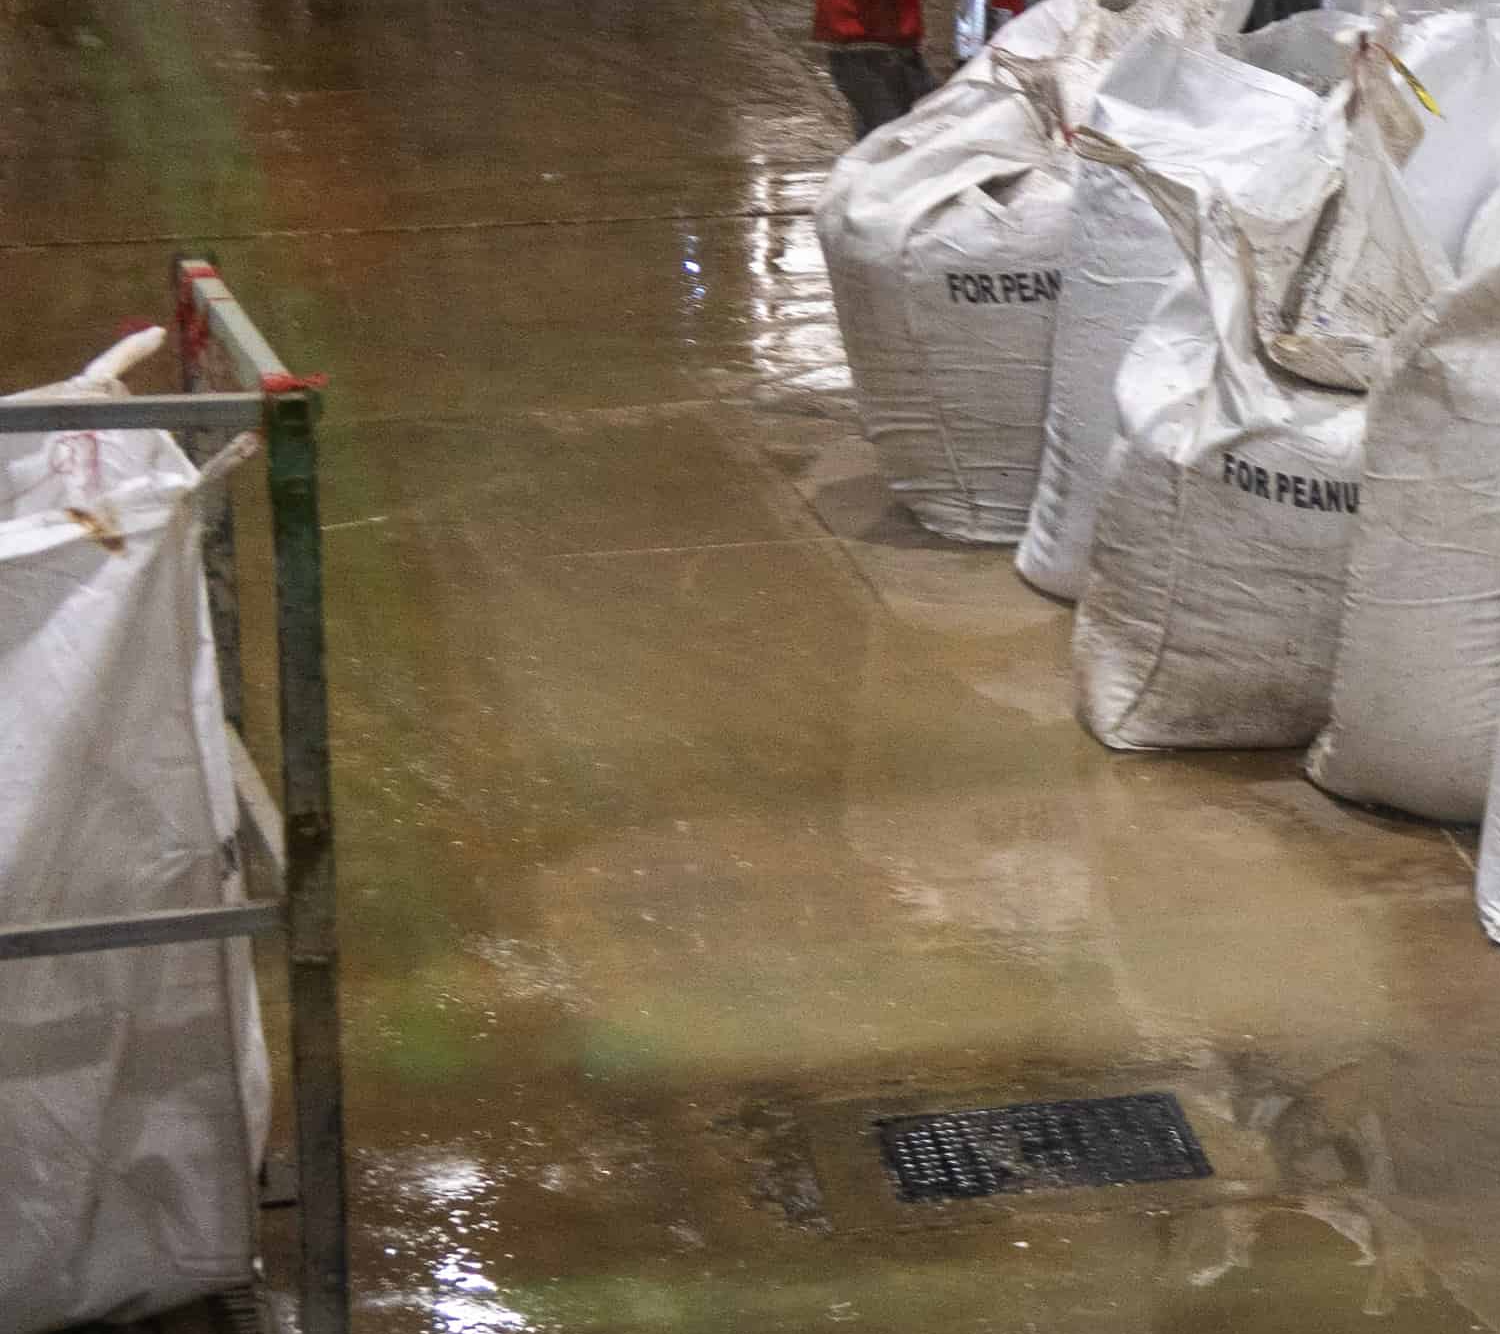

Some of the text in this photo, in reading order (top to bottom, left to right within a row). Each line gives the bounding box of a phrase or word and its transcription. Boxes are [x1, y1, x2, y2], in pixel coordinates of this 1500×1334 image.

[946, 271, 1000, 304] FOR
[1222, 452, 1361, 515] FOR PEANU
